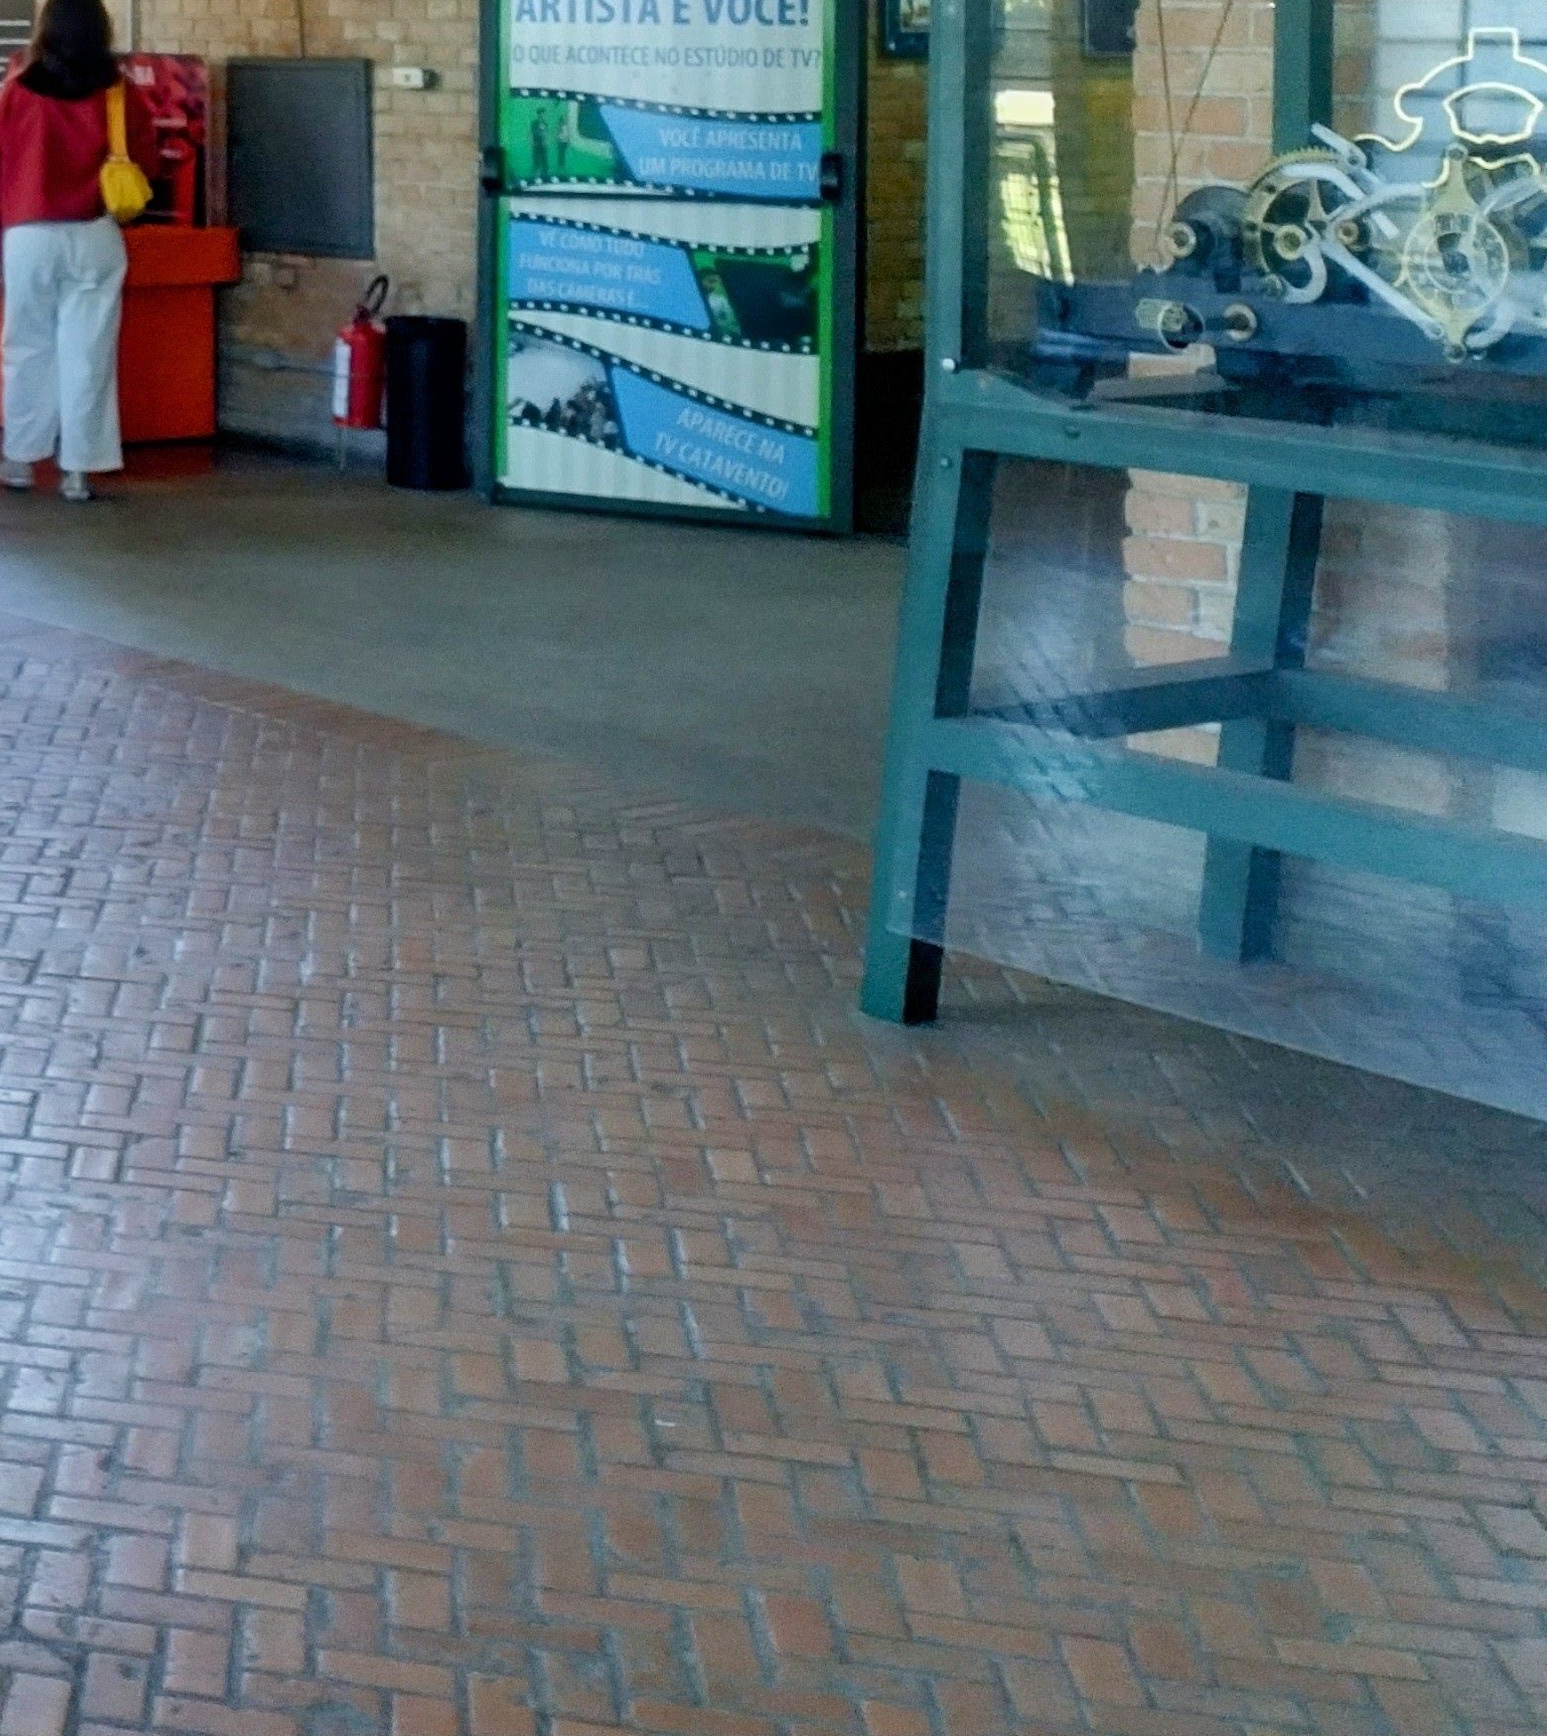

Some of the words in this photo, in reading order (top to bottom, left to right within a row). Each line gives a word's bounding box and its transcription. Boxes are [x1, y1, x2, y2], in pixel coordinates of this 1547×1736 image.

[513, 44, 525, 64] O
[528, 44, 561, 65] QUE
[565, 45, 651, 66] ACONTECE
[657, 46, 681, 66] NO
[685, 43, 760, 68] ESTÚDIO
[763, 47, 785, 69] DE
[790, 49, 821, 69] TV?
[708, 130, 802, 152] APRESENTA
[640, 157, 666, 176] UM
[671, 159, 766, 181] PROGRAMA
[771, 163, 789, 181] DE
[677, 406, 754, 454] APARECE
[759, 437, 785, 464] NA
